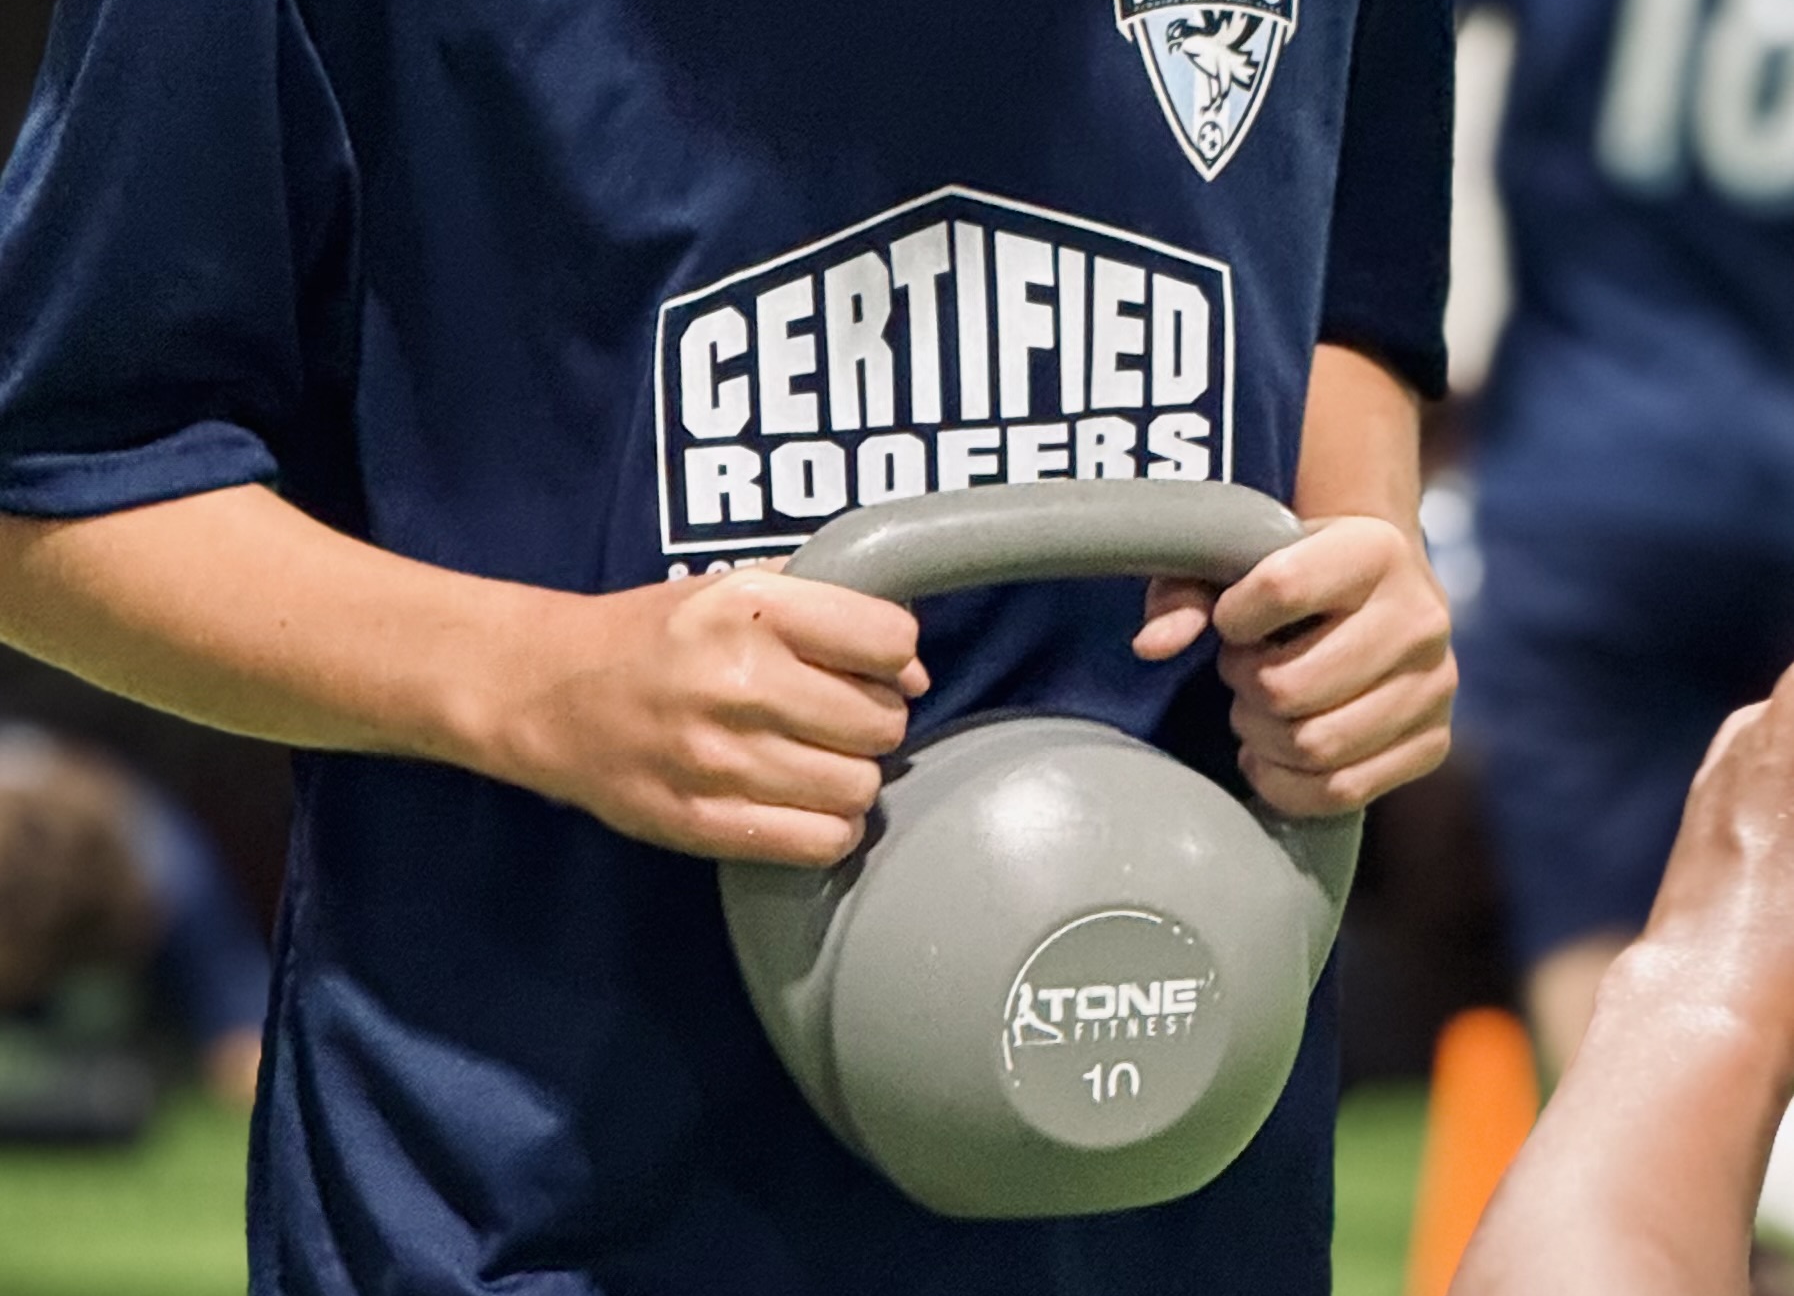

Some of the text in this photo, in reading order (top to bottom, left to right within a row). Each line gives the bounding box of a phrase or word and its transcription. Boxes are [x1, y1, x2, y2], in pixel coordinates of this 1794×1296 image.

[680, 220, 1209, 439] CERTIFIED
[684, 412, 1211, 524] ROOFERS
[1037, 978, 1197, 1023] TONE
[1082, 1061, 1140, 1103] 10
